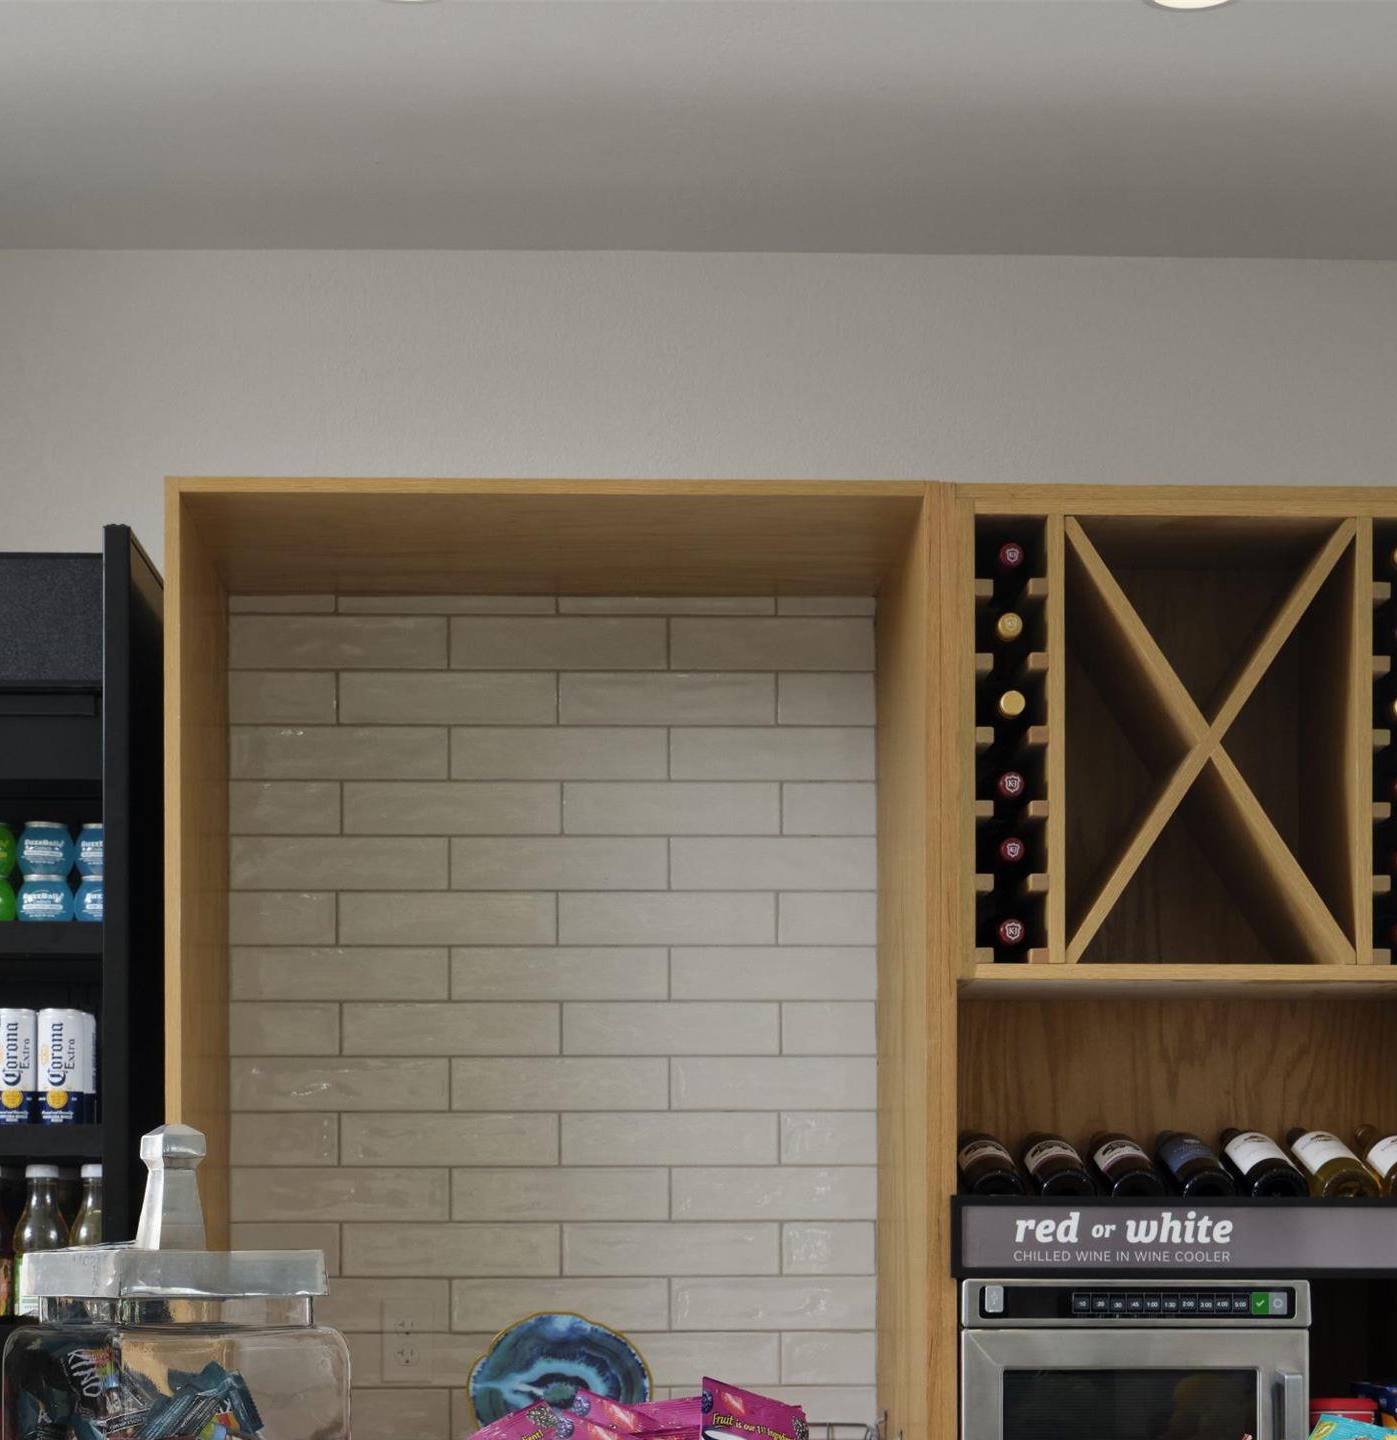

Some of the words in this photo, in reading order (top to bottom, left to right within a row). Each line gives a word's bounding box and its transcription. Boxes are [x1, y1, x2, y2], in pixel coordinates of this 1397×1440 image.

[1, 1021, 22, 1087] Corona
[18, 1038, 31, 1071] Extra
[46, 1021, 67, 1087] Corona
[64, 1038, 76, 1071] Extra
[1013, 1209, 1081, 1245] red
[1091, 1220, 1117, 1240] or
[1125, 1209, 1235, 1246] white
[1012, 1250, 1072, 1263] CHILLED
[1075, 1250, 1114, 1263] WINE
[1116, 1250, 1130, 1263] IN
[1133, 1250, 1172, 1263] WINE
[1174, 1250, 1232, 1263] COOLER
